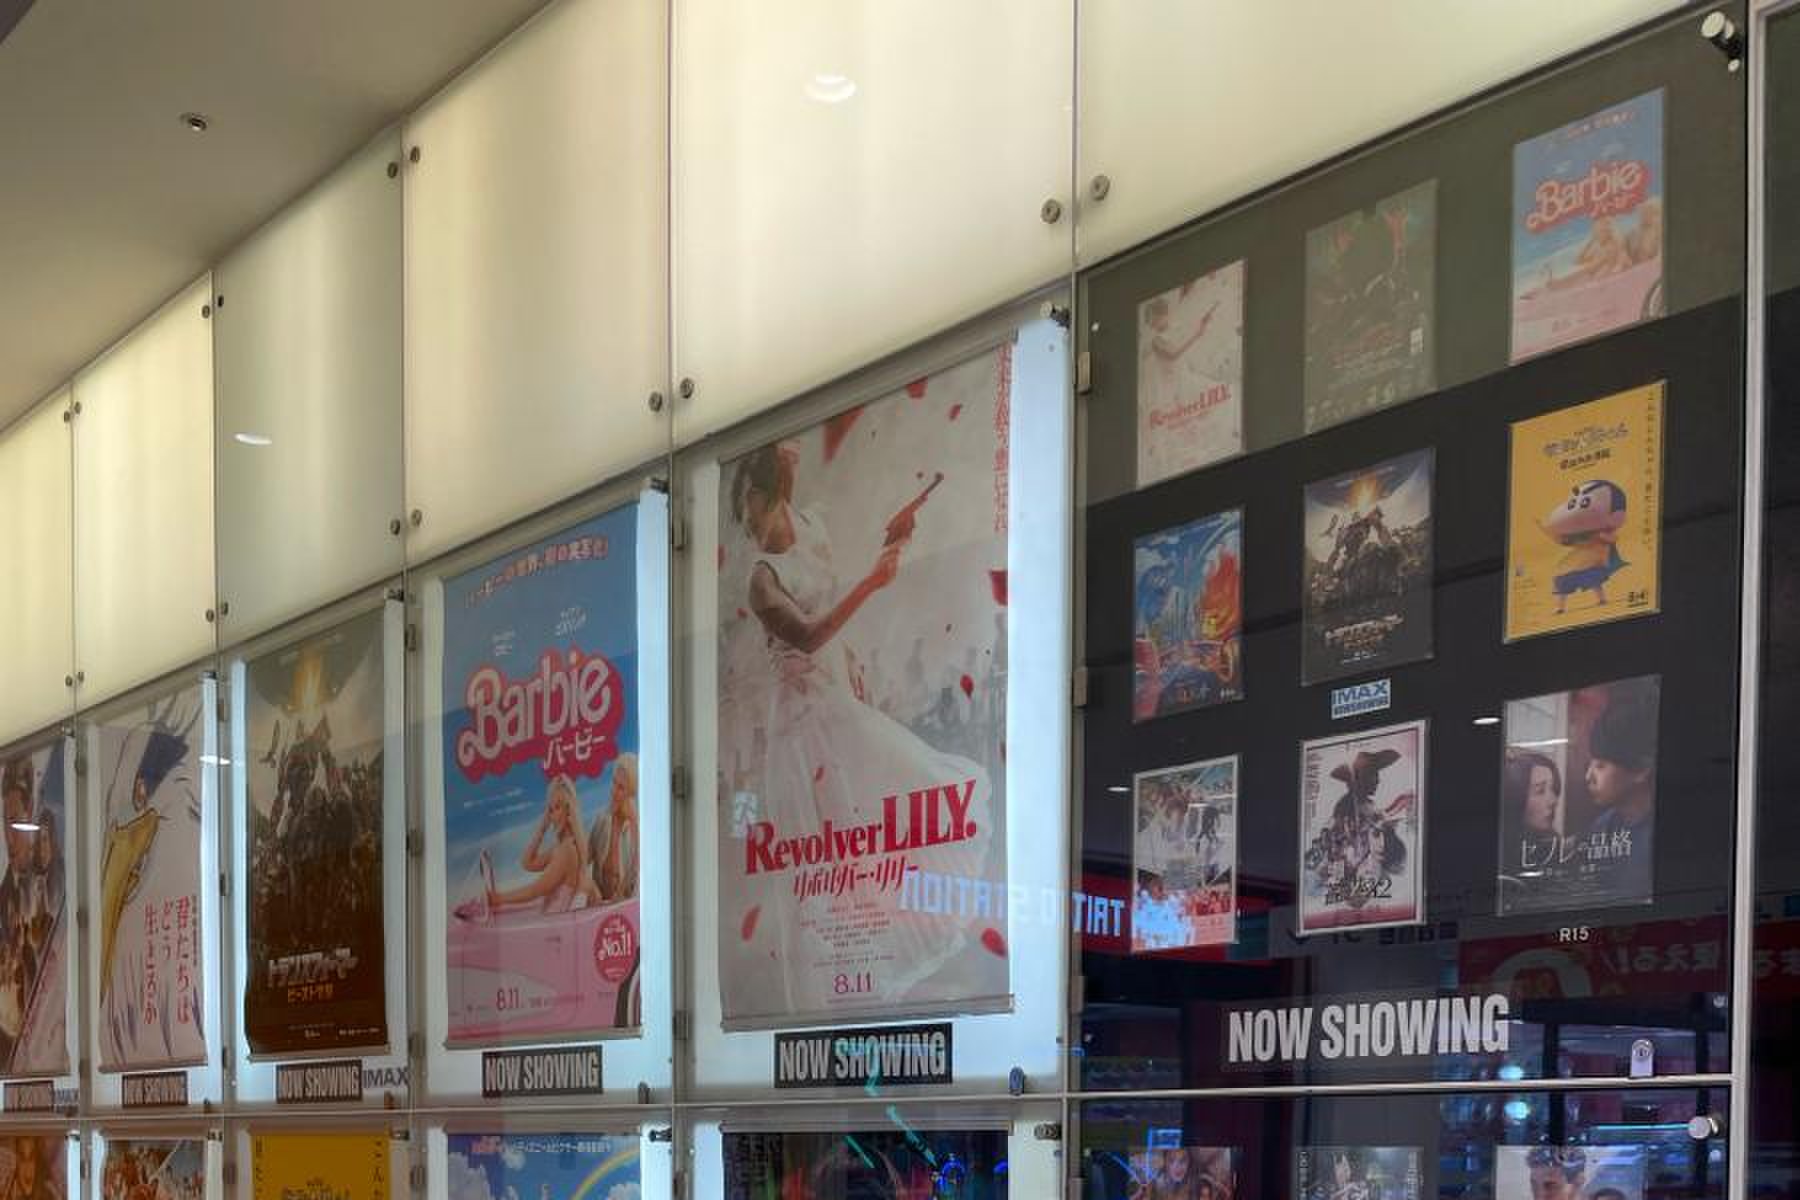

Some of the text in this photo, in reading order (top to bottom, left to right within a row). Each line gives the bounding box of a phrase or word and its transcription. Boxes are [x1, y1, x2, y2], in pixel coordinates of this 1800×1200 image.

[1527, 161, 1642, 231] Barbie
[459, 653, 611, 767] Barbie
[1333, 680, 1388, 705] IMAX
[544, 726, 606, 771] バービー
[745, 819, 883, 875] Revolver
[1559, 926, 1590, 942] R15
[496, 987, 520, 1010] 8.11
[833, 972, 873, 995] 8.11
[1228, 993, 1510, 1063] NOW SHOWING
[484, 1052, 599, 1091] NOW SHOWING
[779, 1031, 946, 1081] NOW SHOWING
[305, 1065, 361, 1099] SHOWING
[363, 1067, 410, 1088] IMAX
